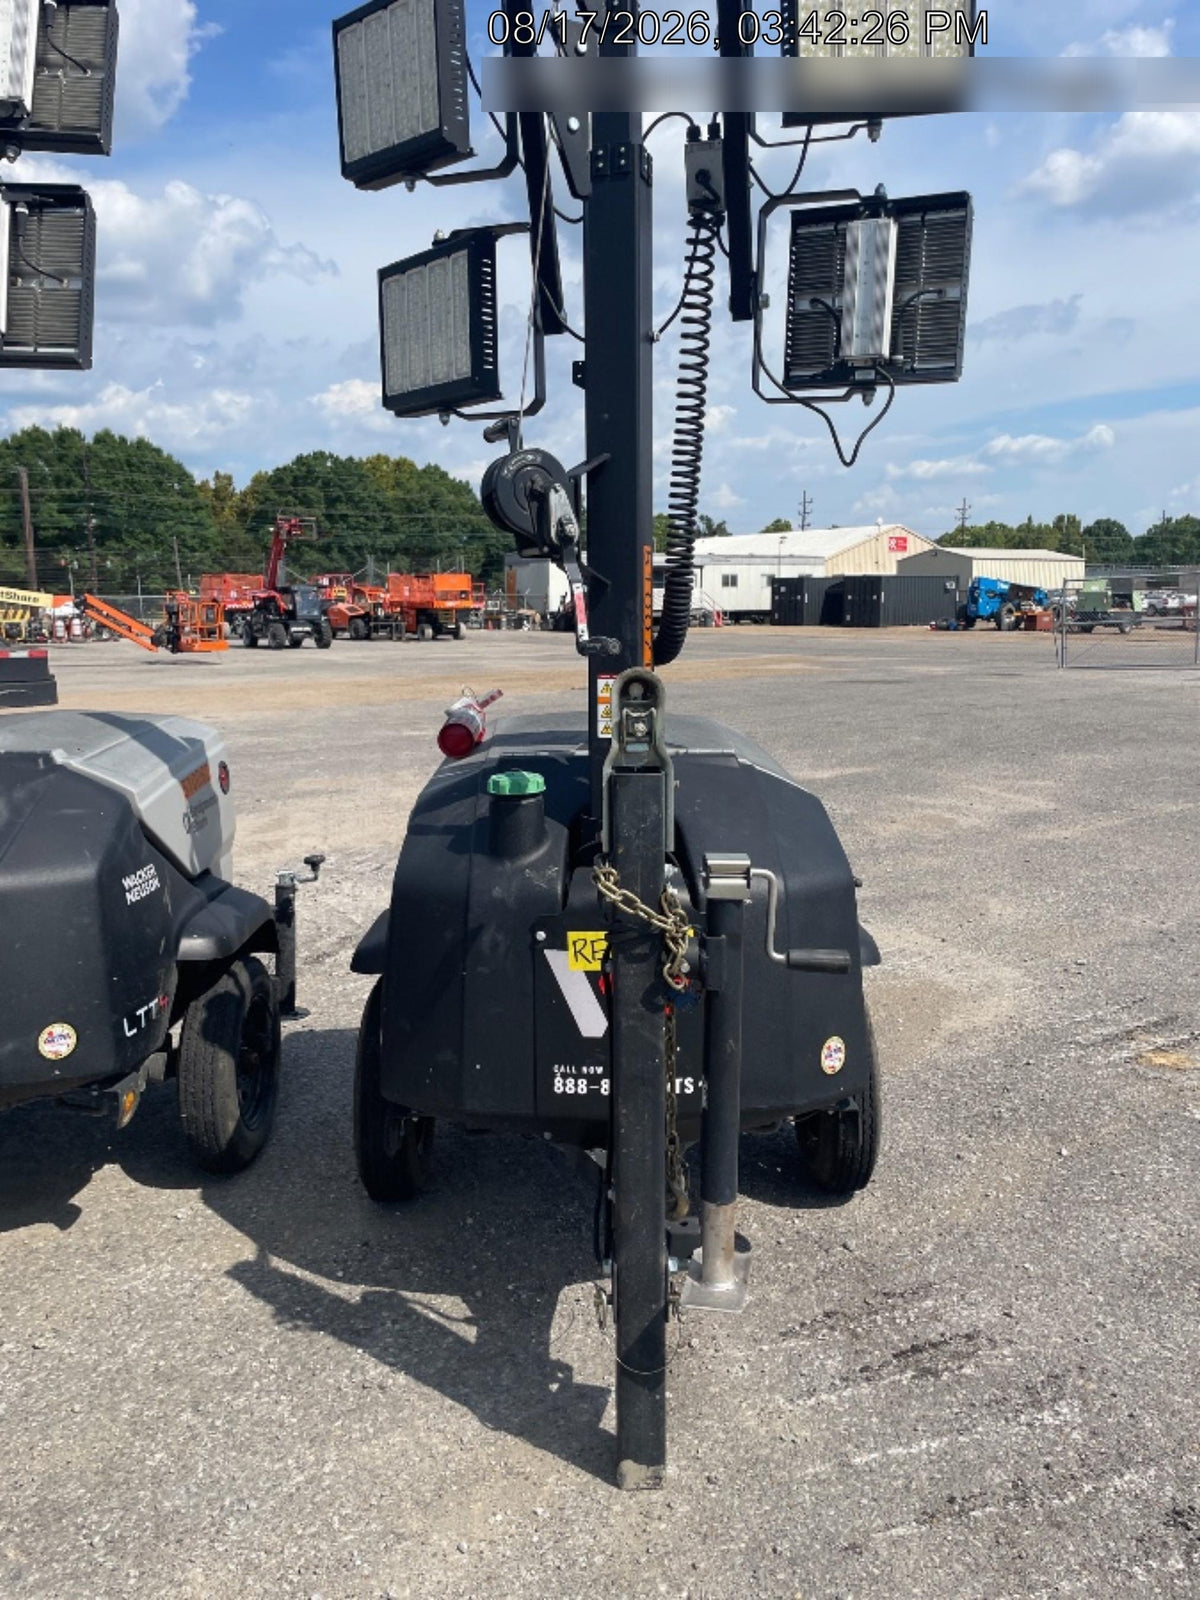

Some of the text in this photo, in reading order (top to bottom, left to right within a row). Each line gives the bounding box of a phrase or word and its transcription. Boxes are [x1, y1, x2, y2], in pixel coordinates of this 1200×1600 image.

[122, 863, 157, 890] WACKER
[572, 938, 608, 964] RE
[553, 1064, 577, 1074] CALL
